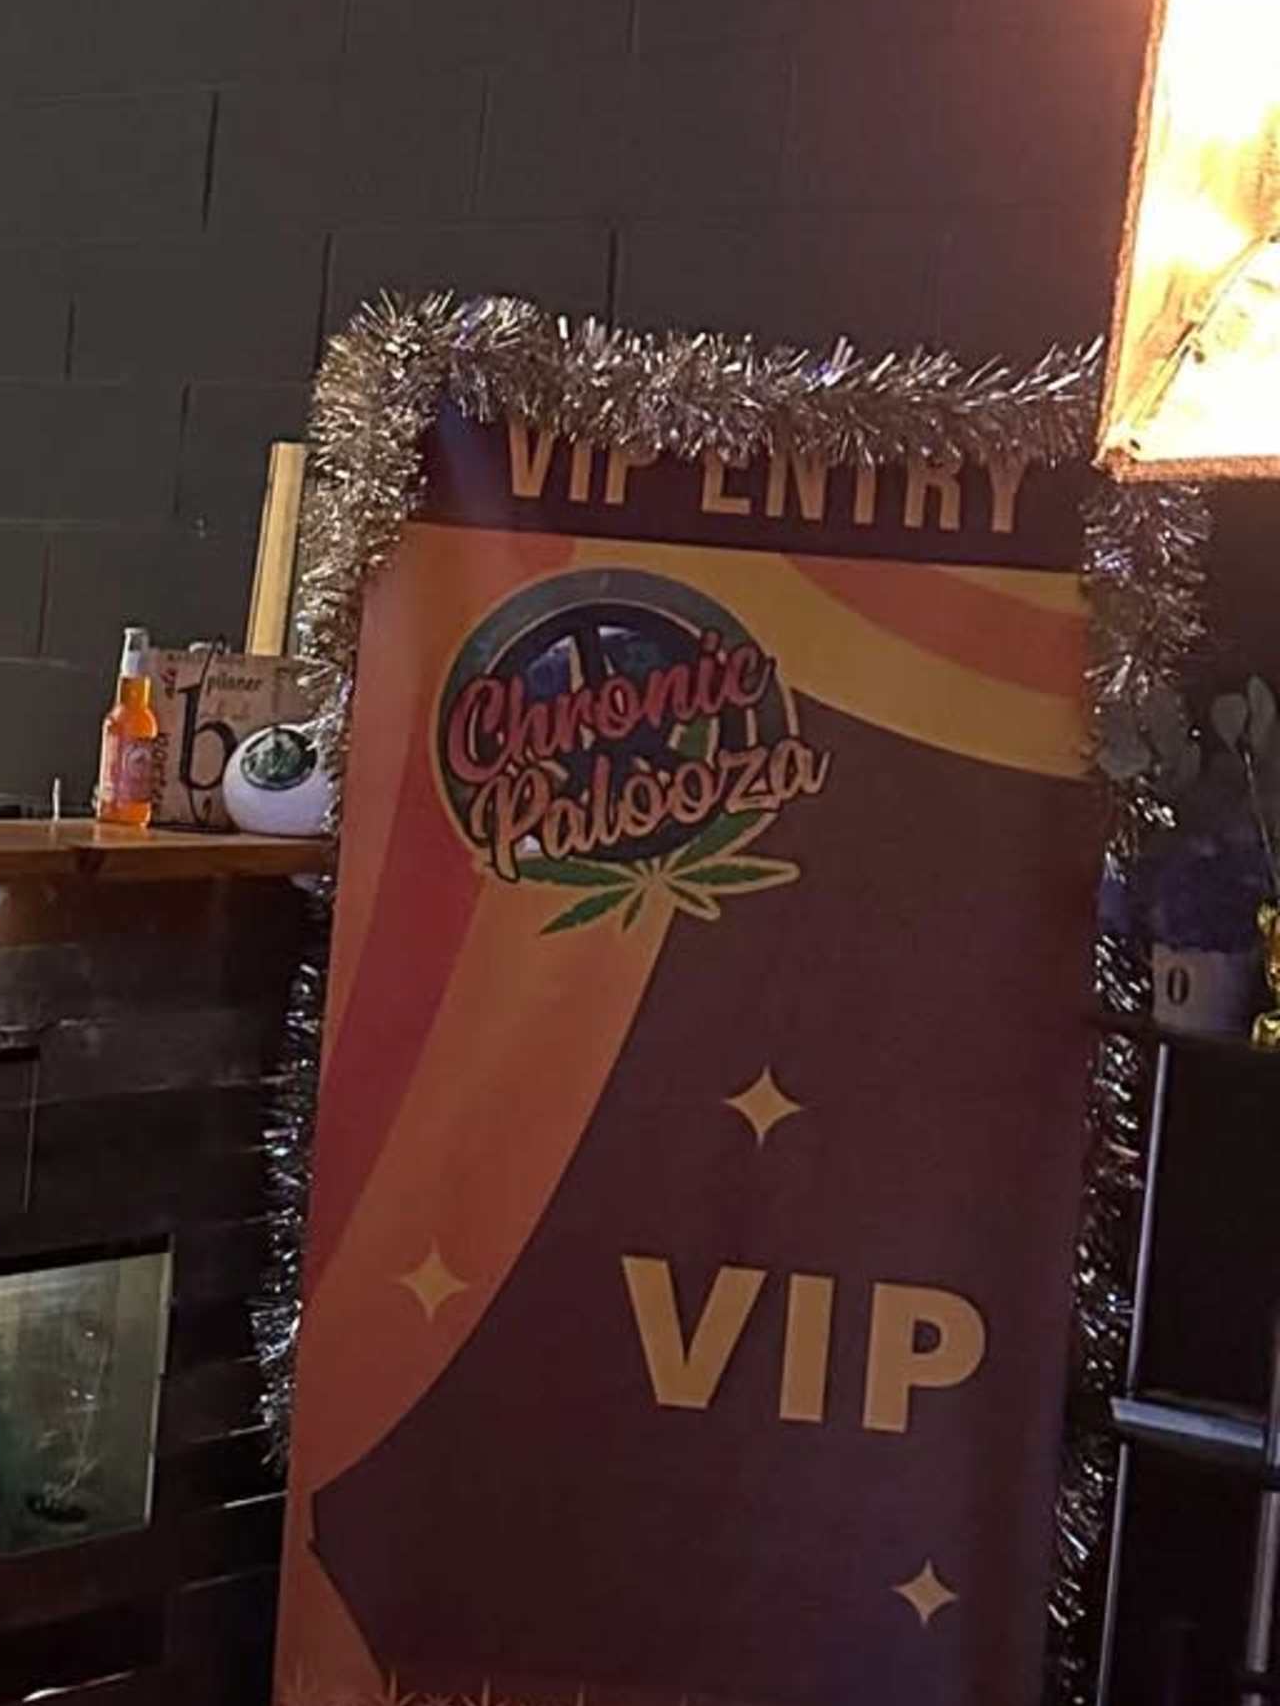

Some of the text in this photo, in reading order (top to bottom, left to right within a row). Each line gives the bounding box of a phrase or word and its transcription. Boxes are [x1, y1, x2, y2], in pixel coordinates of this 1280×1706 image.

[508, 417, 660, 506] VIP
[445, 626, 776, 785] Chronic
[470, 733, 834, 882] Palooza
[620, 1254, 986, 1434] VIP
